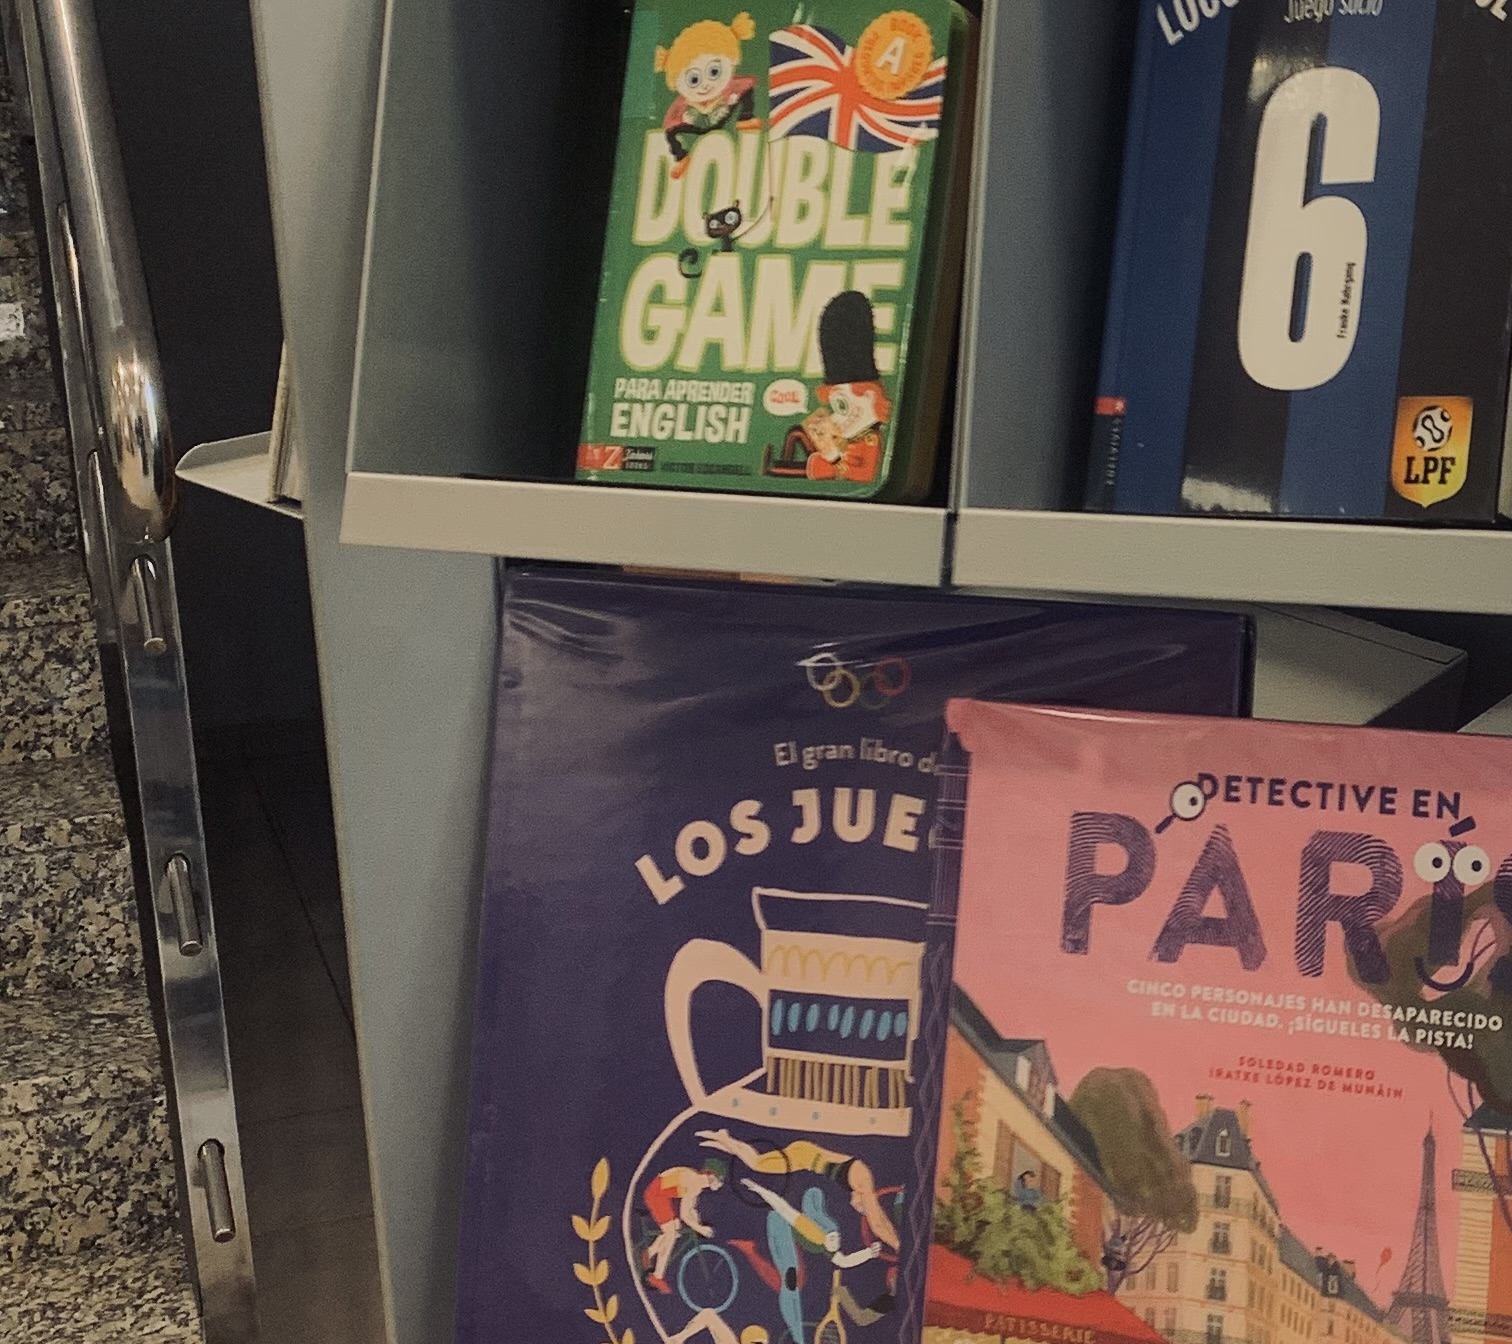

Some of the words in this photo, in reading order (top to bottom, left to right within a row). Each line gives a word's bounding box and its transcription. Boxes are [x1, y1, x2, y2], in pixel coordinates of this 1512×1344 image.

[633, 130, 914, 249] DOUBLE
[1236, 64, 1382, 392] 6
[621, 252, 905, 376] GAME
[613, 377, 662, 401] PARA
[663, 378, 756, 406] APRENDER
[609, 402, 751, 444] ENGLISH
[1403, 456, 1457, 487] LPF
[773, 740, 798, 767] El
[802, 743, 856, 771] gran
[859, 737, 914, 768] libro
[1197, 771, 1397, 817] DETECTIVE
[1411, 789, 1462, 820] EN
[633, 798, 772, 905] LOS
[790, 786, 941, 853] JUE
[1126, 978, 1187, 1000] CINCO
[1190, 985, 1306, 1012] PERSONAJES
[1310, 996, 1353, 1017] HAN
[1356, 999, 1504, 1032] DESAPARECIDO
[1151, 1001, 1176, 1017] EN
[1179, 1004, 1203, 1021] LA
[1386, 1025, 1411, 1043] LA
[1414, 1026, 1475, 1051] PISTA!
[1237, 1055, 1306, 1075] SOLEDAD
[1310, 1062, 1377, 1082] ROMERO
